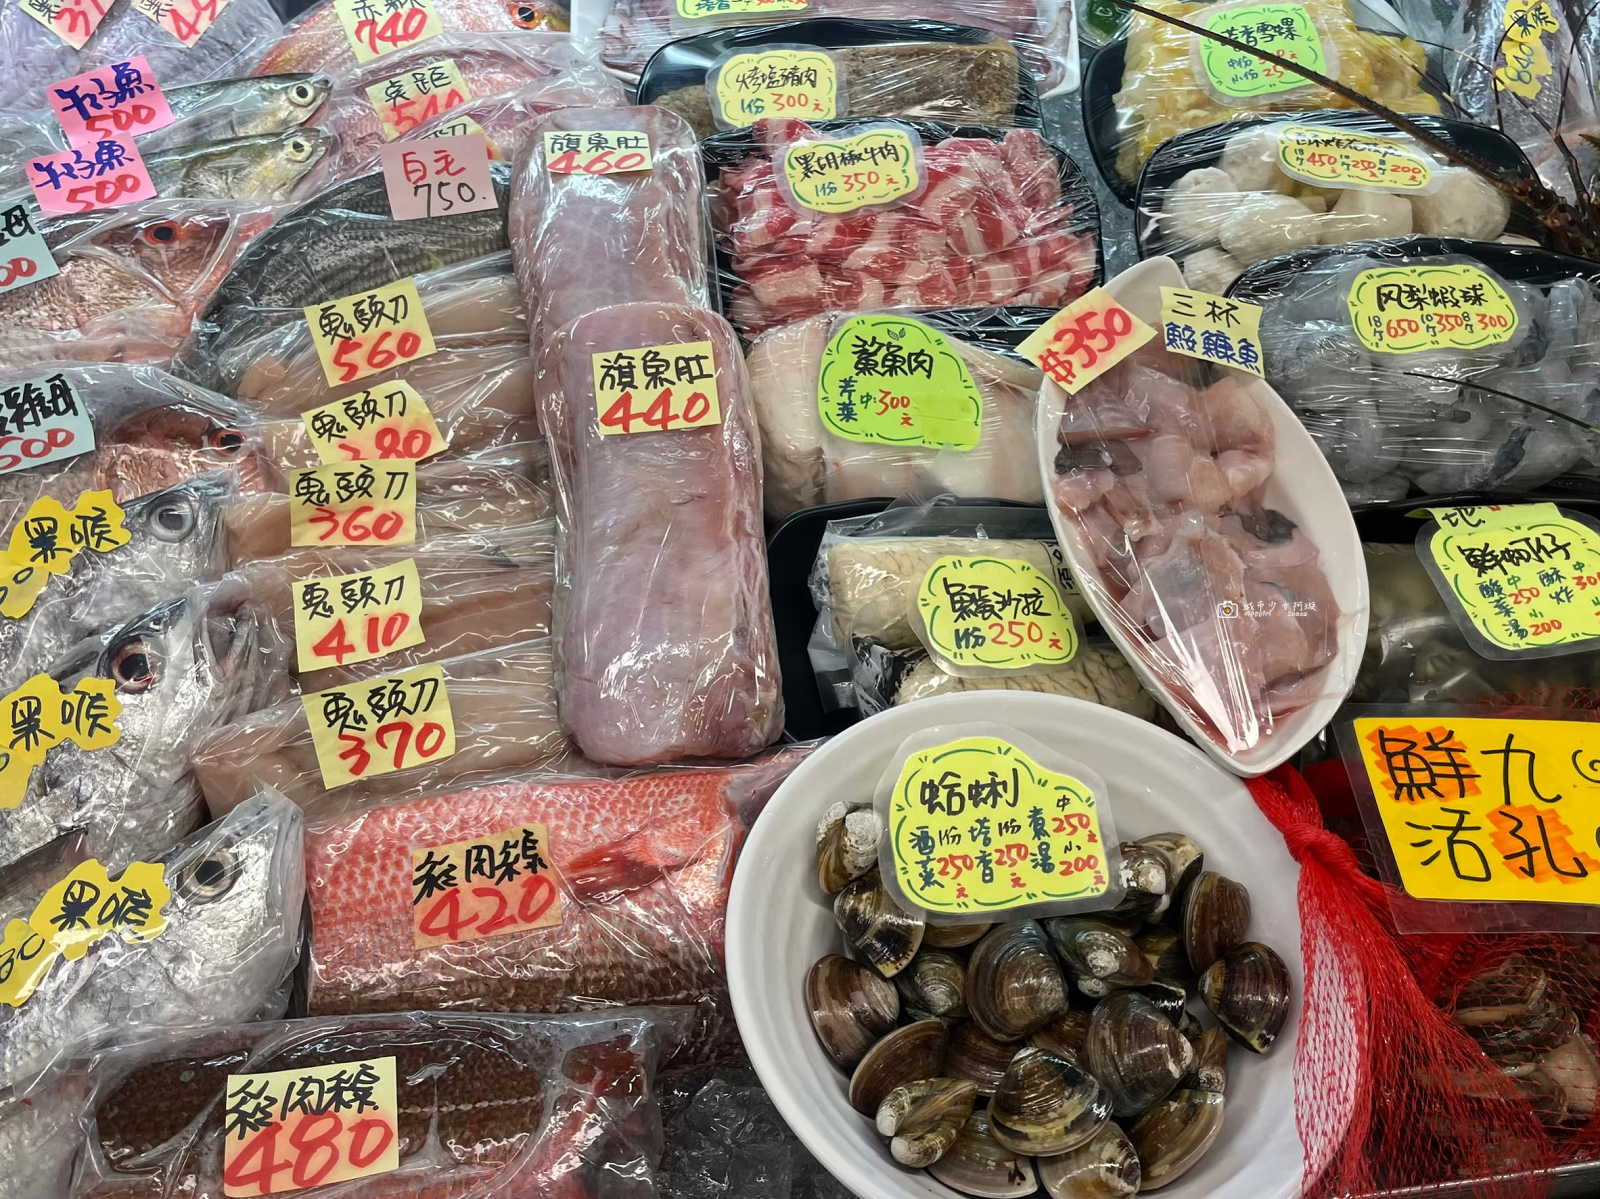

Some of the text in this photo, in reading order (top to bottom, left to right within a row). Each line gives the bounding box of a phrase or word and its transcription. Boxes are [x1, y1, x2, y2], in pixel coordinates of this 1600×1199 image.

[354, 8, 428, 54] 740
[1504, 42, 1534, 84] 840
[85, 104, 156, 139] 500
[546, 150, 646, 175] 460
[550, 132, 649, 154] 旗魚肚
[794, 141, 900, 183] 黑胡椒牛肉
[1306, 152, 1337, 167] 450
[1351, 159, 1377, 171] 250
[1390, 164, 1422, 174] 200
[66, 173, 141, 211] 500
[319, 294, 408, 346] 鬼頭刀
[1171, 292, 1241, 328] 三杯
[1386, 318, 1419, 338] 650
[1433, 312, 1464, 333] 350
[1475, 313, 1508, 331] 300
[332, 331, 422, 383] 560
[1038, 307, 1133, 386] $350
[600, 349, 714, 392] 旗魚肚
[311, 390, 407, 443] 鬼頭刀
[600, 387, 710, 434] 440
[295, 464, 409, 507] 鬼頭刀
[309, 505, 404, 542] 360
[302, 575, 405, 620] 鬼頭刀
[1508, 587, 1540, 605] 250
[312, 612, 410, 664] 410
[1529, 619, 1563, 637] 200
[9, 690, 111, 752] 黑喉
[320, 678, 439, 735] 鬼頭刀
[338, 720, 446, 776] 370
[919, 767, 1019, 816] 蛤蜊
[1051, 813, 1091, 836] 250
[936, 854, 974, 879] 250
[994, 843, 1029, 868] 250
[1059, 854, 1099, 876] 200
[419, 875, 556, 941] 420
[224, 1110, 394, 1194] 480
